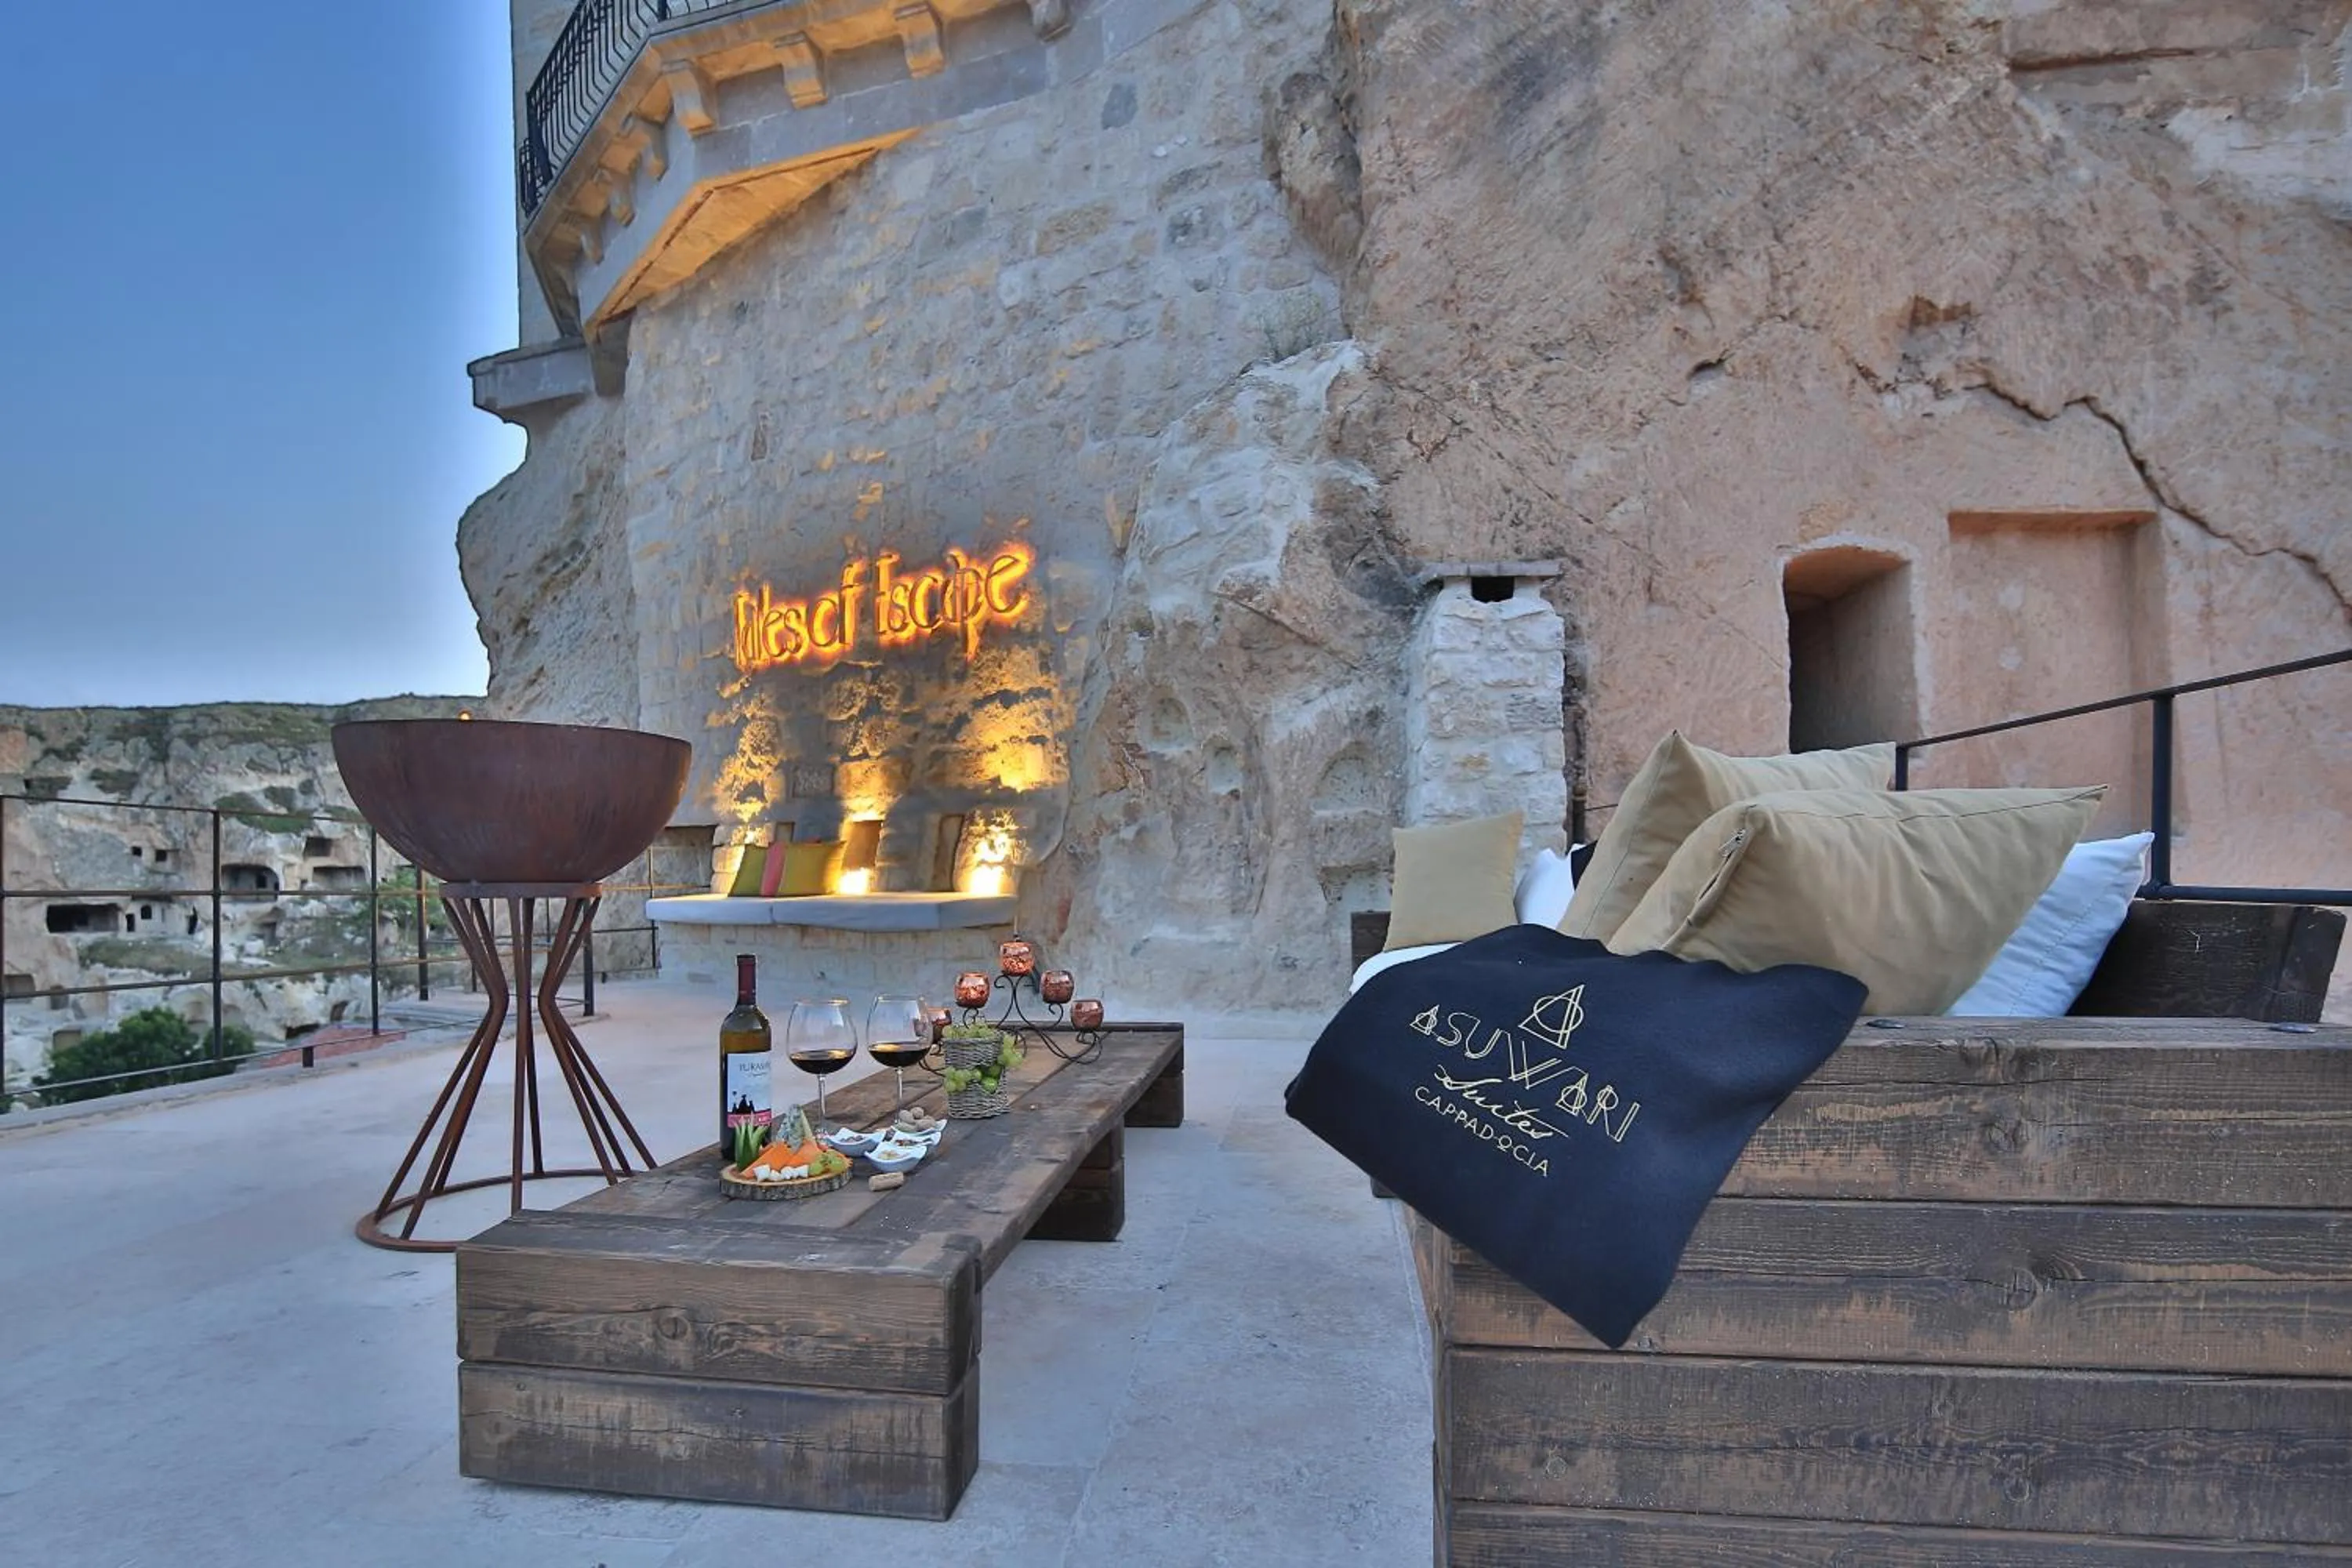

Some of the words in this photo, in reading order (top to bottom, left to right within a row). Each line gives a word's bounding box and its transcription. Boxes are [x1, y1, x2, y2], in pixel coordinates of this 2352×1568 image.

[808, 561, 865, 648] of
[1414, 1086, 1549, 1177] CAPPADOCIA
[1433, 1064, 1569, 1139] Suites
